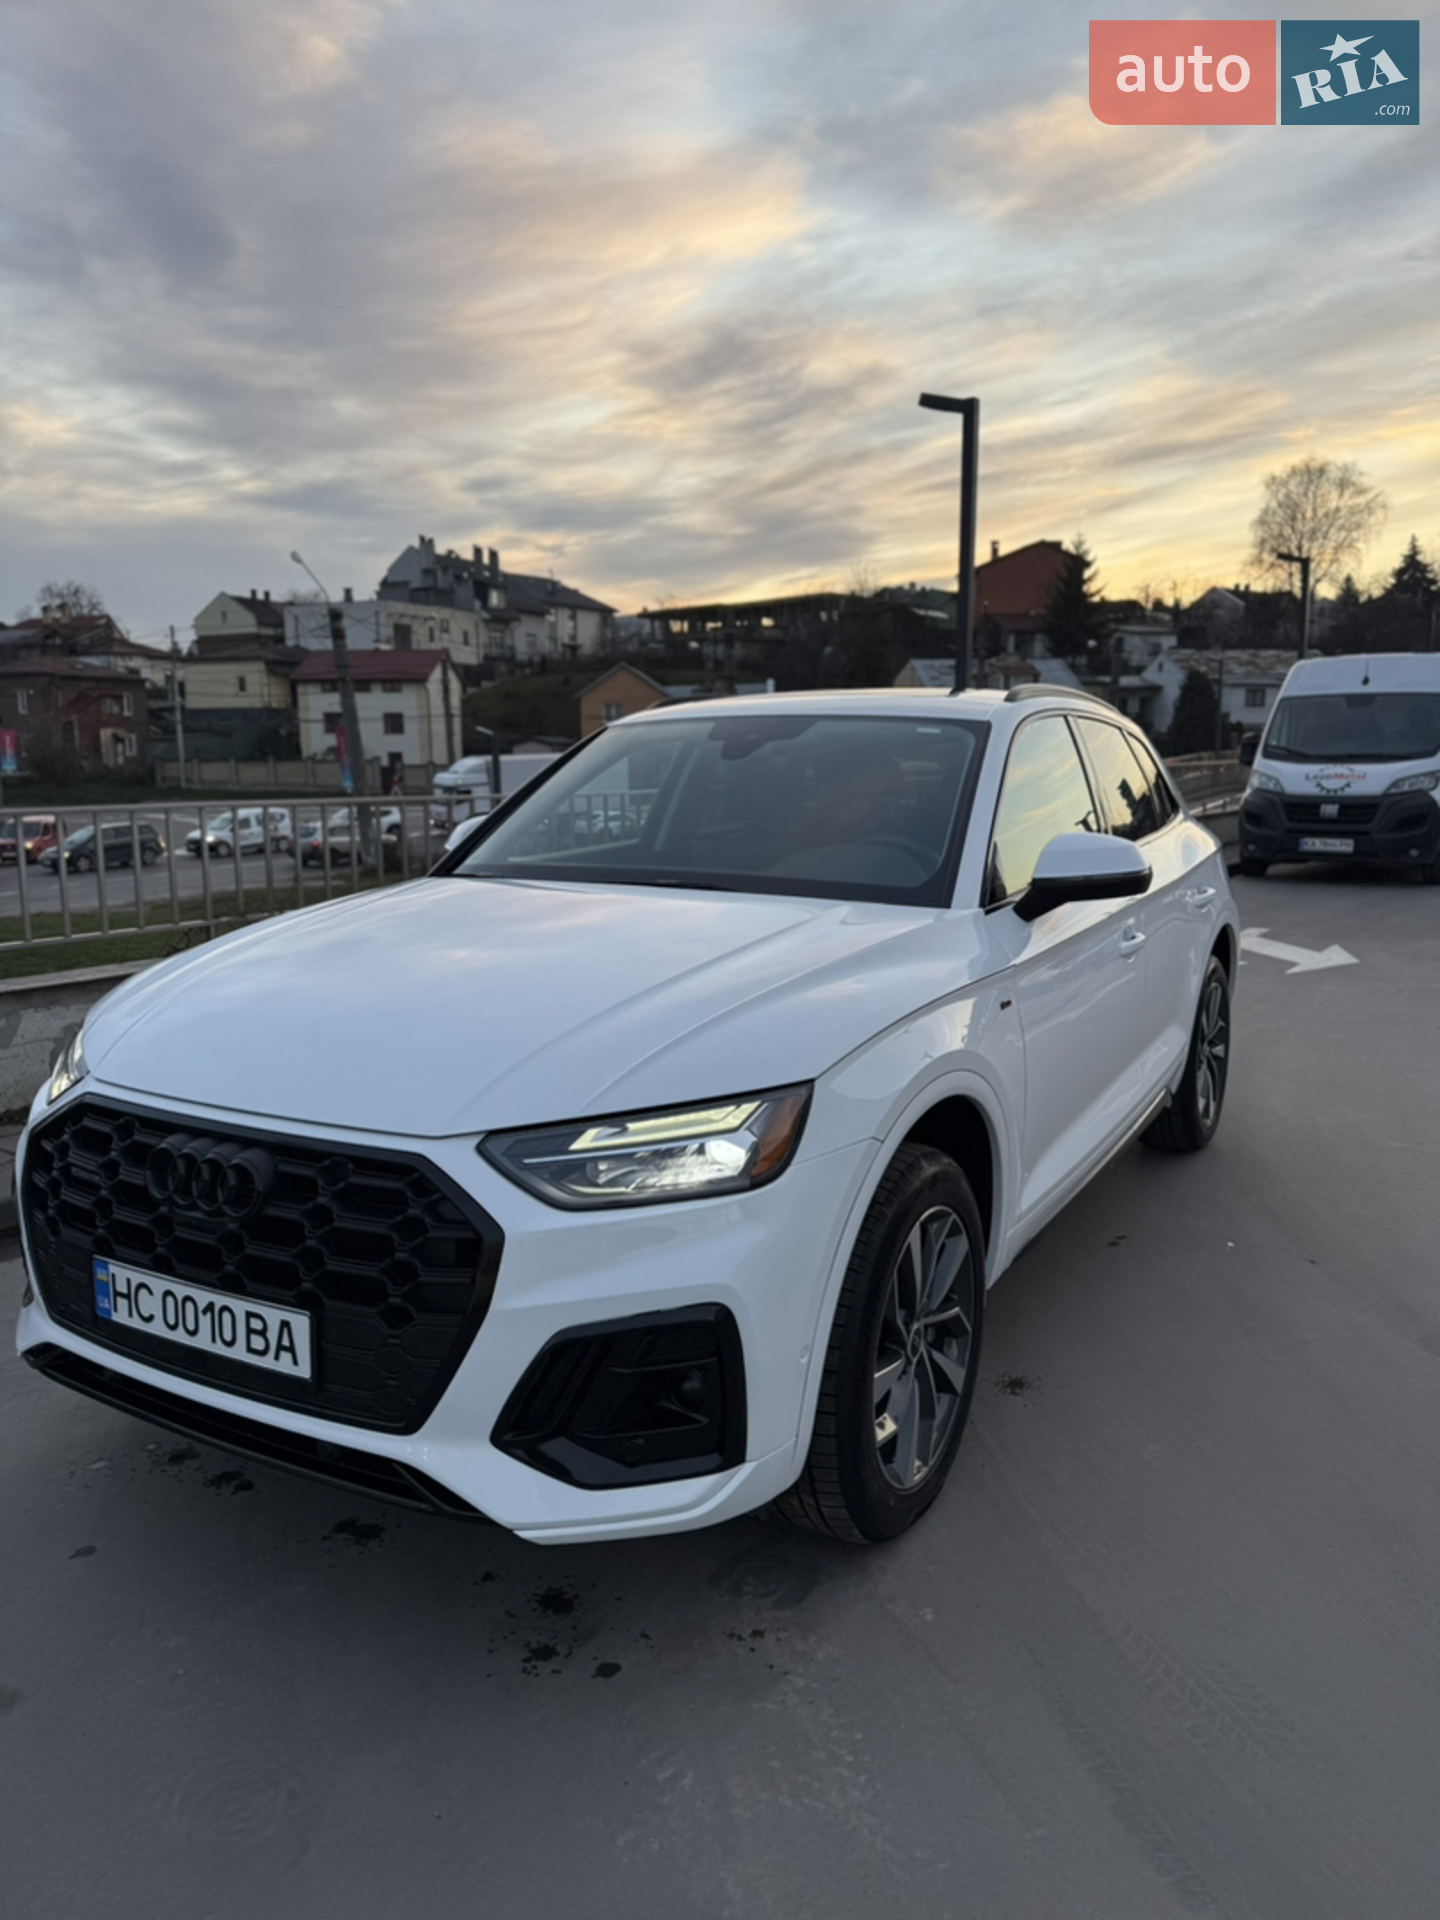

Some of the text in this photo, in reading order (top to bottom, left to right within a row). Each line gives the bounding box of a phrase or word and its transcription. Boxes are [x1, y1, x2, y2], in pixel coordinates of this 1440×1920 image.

[111, 1272, 299, 1367] HC 0010 BA
